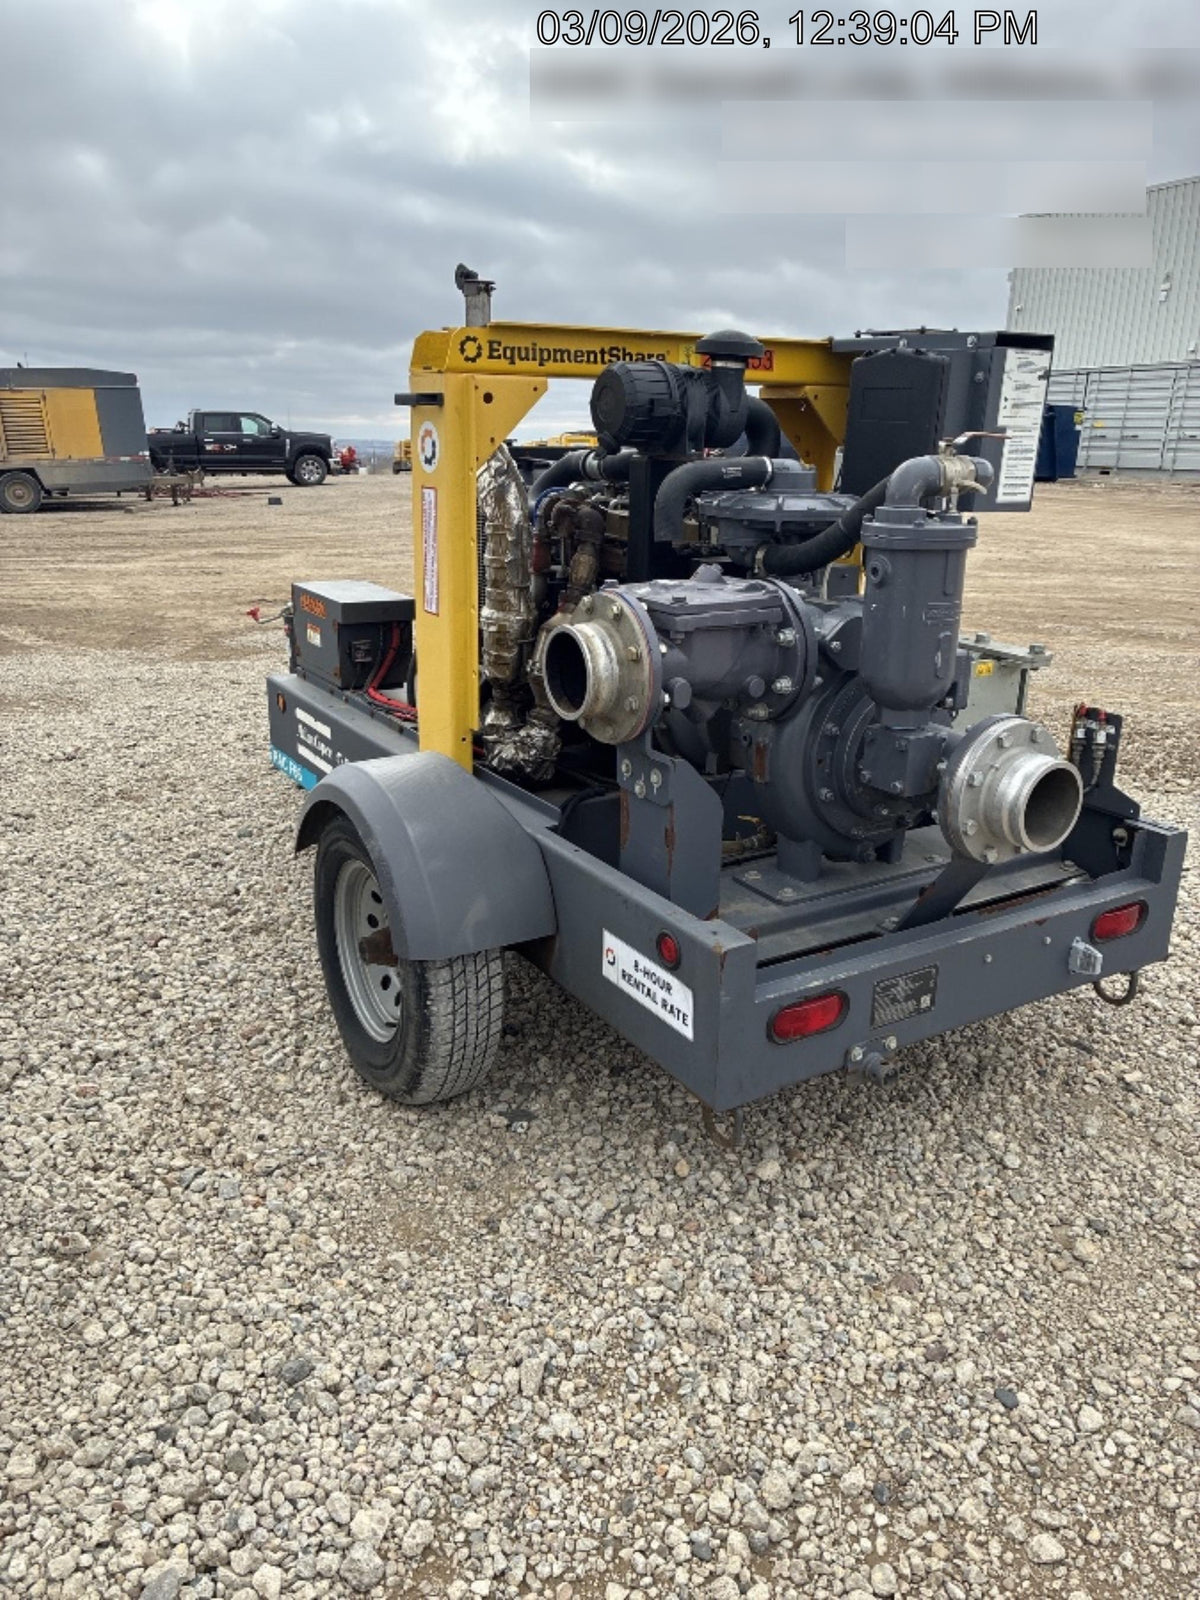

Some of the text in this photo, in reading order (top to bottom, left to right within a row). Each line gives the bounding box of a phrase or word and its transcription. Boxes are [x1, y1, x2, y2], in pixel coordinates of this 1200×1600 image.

[487, 340, 666, 366] EquipmentShare
[634, 960, 673, 995] 8-HOUR
[622, 968, 689, 1027] RENTAL RATE
